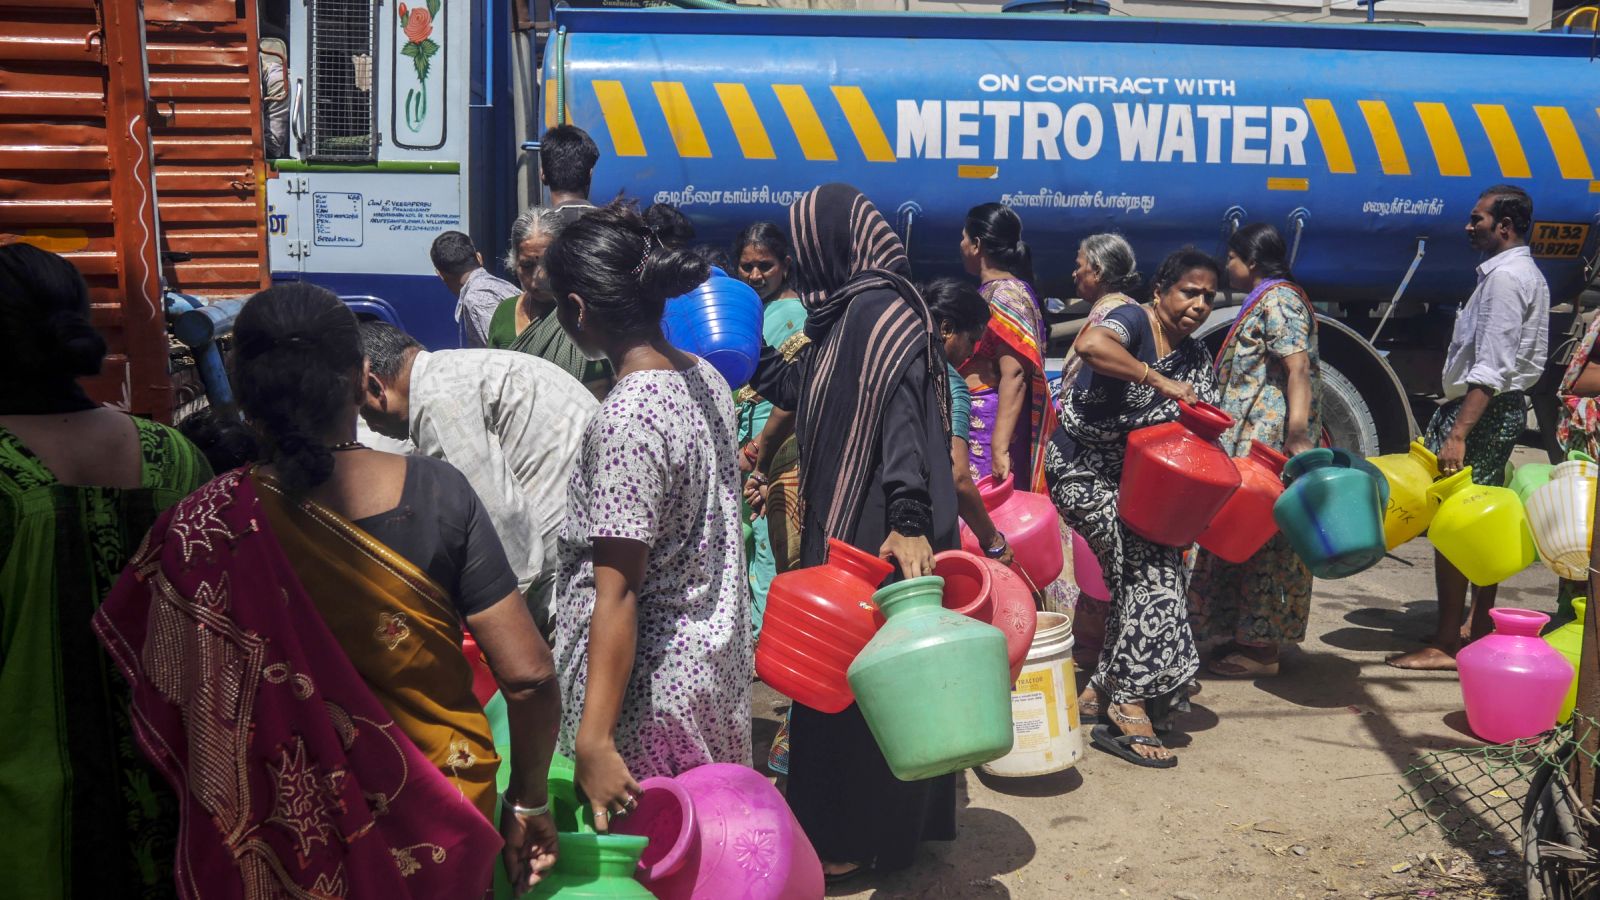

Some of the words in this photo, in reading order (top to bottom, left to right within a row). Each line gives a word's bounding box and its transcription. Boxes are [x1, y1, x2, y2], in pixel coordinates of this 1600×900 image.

[978, 74, 1020, 92] ON
[1026, 75, 1169, 95] CONTRACT
[1174, 78, 1236, 97] WITH
[896, 99, 1104, 161] METRO
[1113, 102, 1309, 165] WATER
